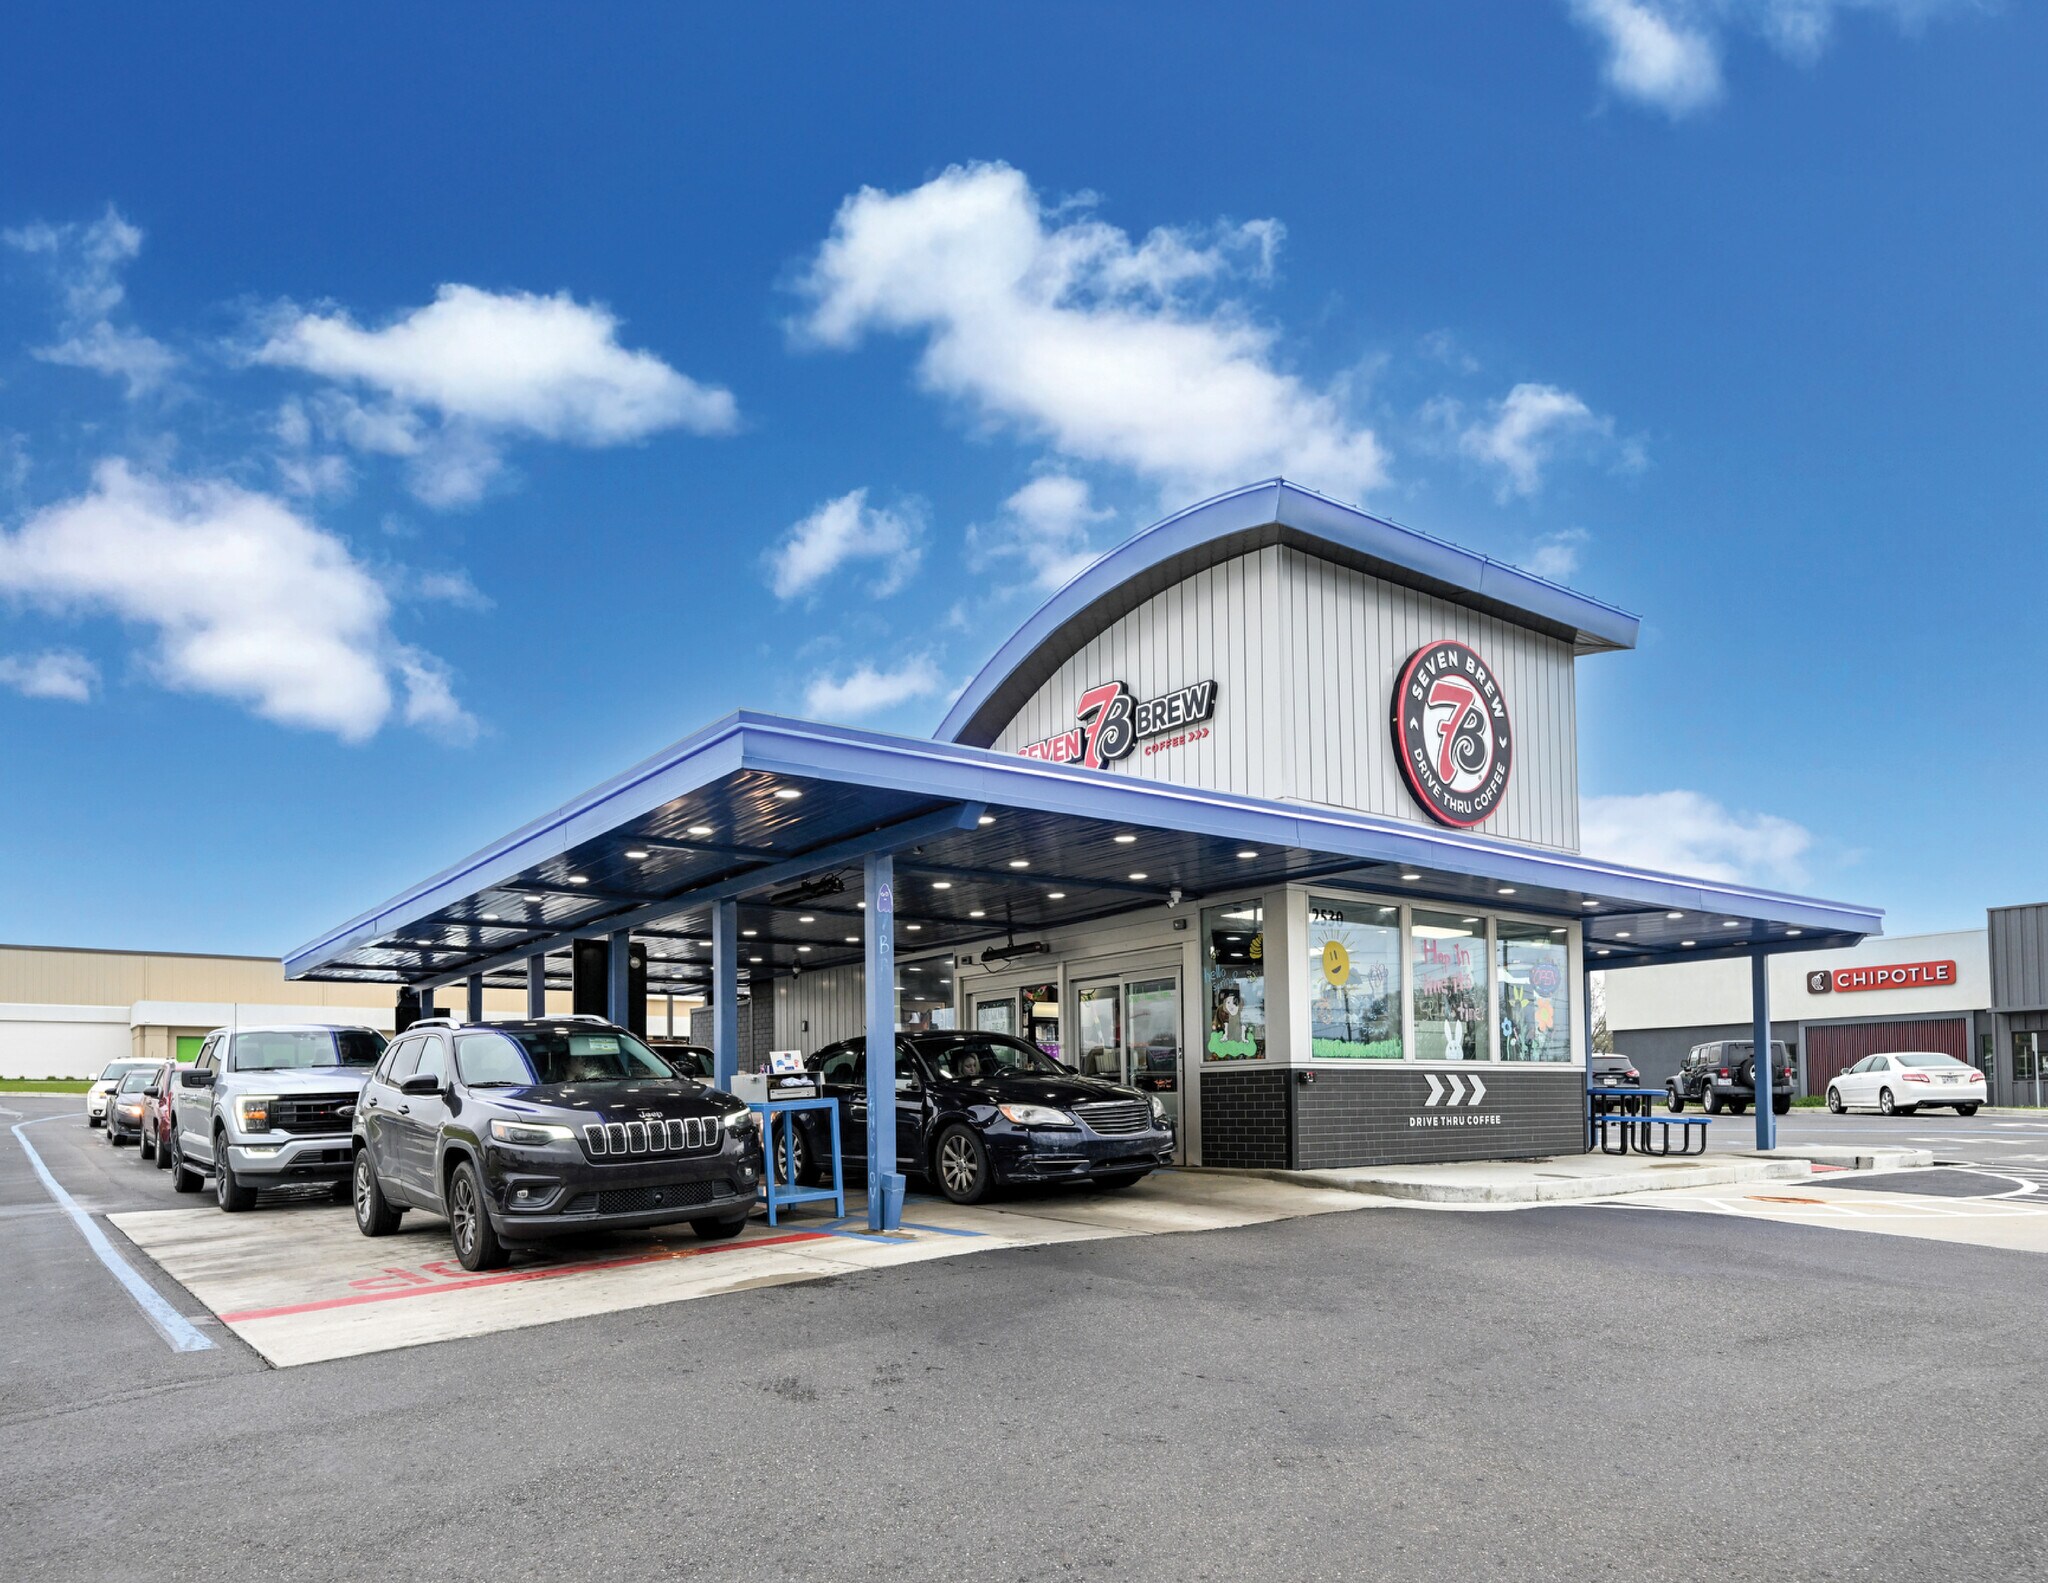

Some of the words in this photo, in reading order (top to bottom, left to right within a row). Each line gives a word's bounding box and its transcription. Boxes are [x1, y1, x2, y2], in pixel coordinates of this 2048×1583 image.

[1411, 651, 1458, 701] SEVEN
[1464, 656, 1504, 718] BREW
[1136, 681, 1210, 738] BREW
[1144, 736, 1186, 757] COFFEE
[1414, 748, 1440, 798] DRIVE
[1443, 793, 1471, 814] THRU
[1474, 761, 1505, 811] COFFEE
[1311, 907, 1344, 927] 2530
[1423, 939, 1451, 972] Hop
[1454, 943, 1471, 966] in
[1204, 964, 1227, 983] hello
[1838, 965, 1948, 987] CHIPOTLE
[638, 1111, 664, 1119] Jeep
[1409, 1117, 1438, 1127] DRIVE
[1440, 1116, 1465, 1126] THRU
[1467, 1115, 1501, 1125] COFFEE
